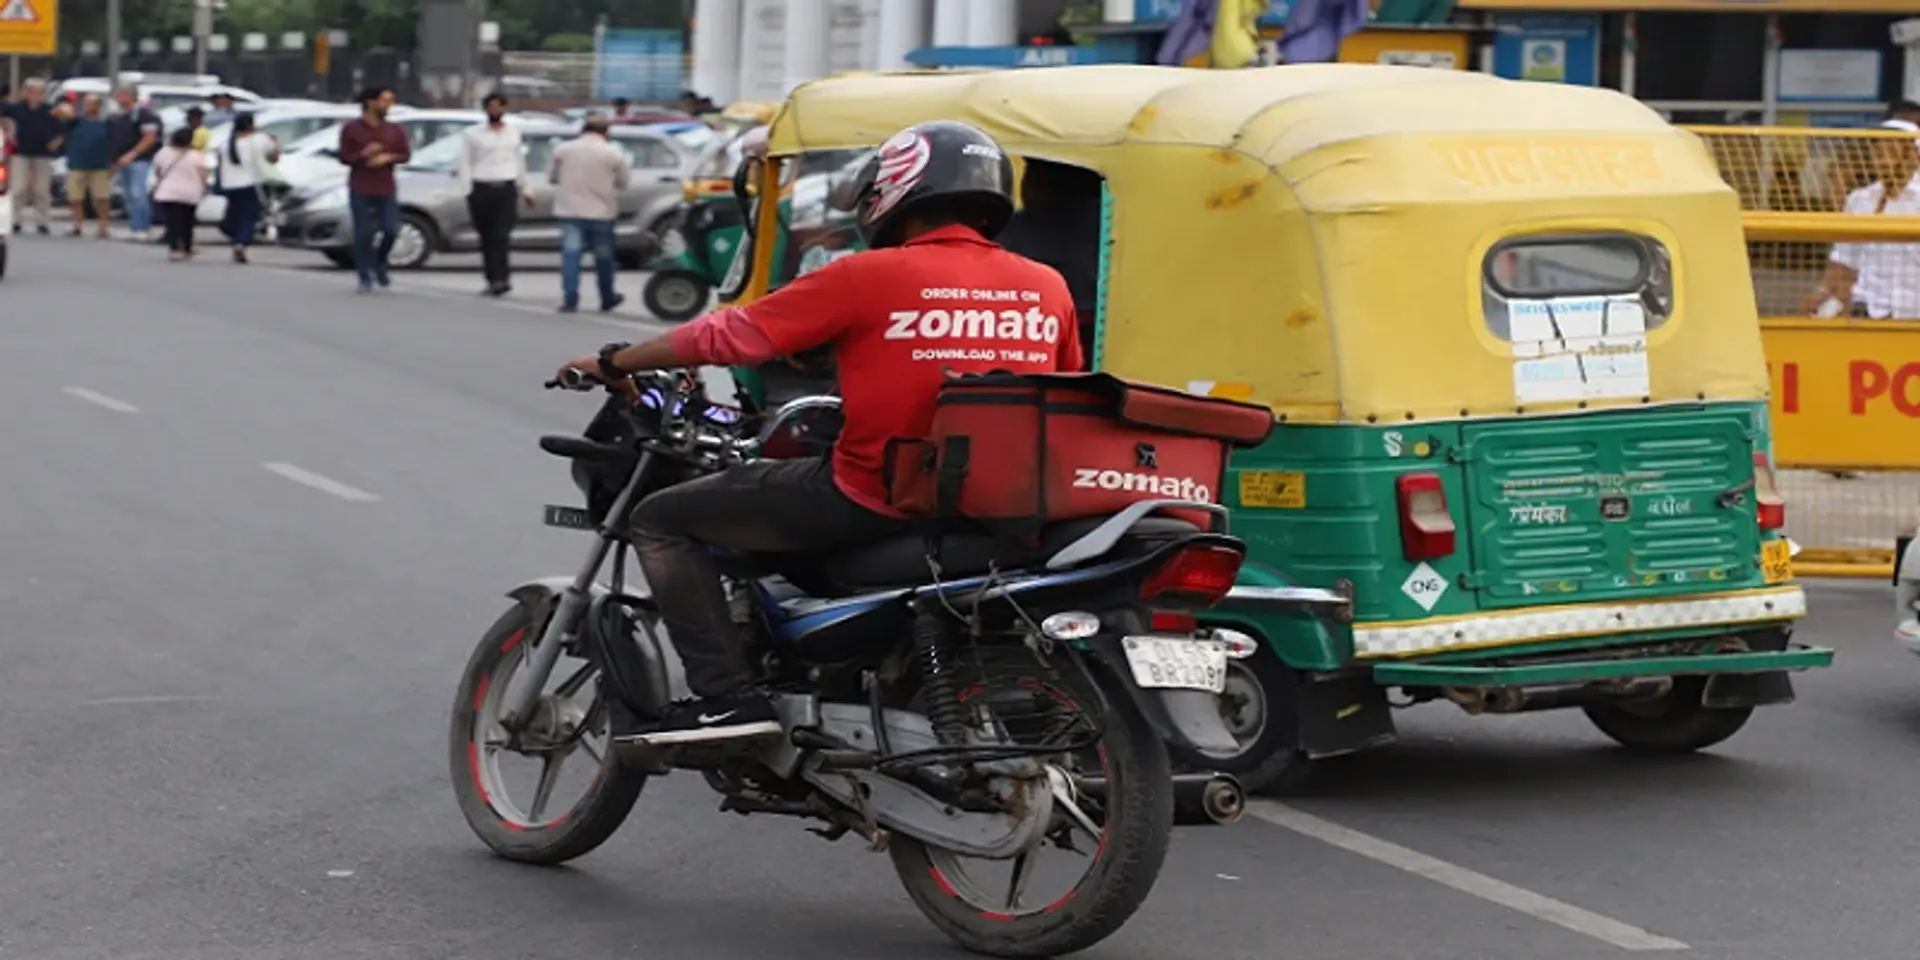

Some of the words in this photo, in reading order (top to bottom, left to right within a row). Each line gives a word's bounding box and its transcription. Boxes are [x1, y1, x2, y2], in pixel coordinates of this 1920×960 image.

[920, 287, 969, 300] ORDER
[970, 288, 1018, 302] ONLINE
[1020, 290, 1041, 302] ON
[883, 305, 1060, 344] zomato
[912, 348, 996, 361] DOWNLOAD
[1000, 349, 1024, 362] THE
[1025, 350, 1048, 363] APP
[1072, 467, 1210, 504] zomato
[1410, 577, 1440, 594] CNG
